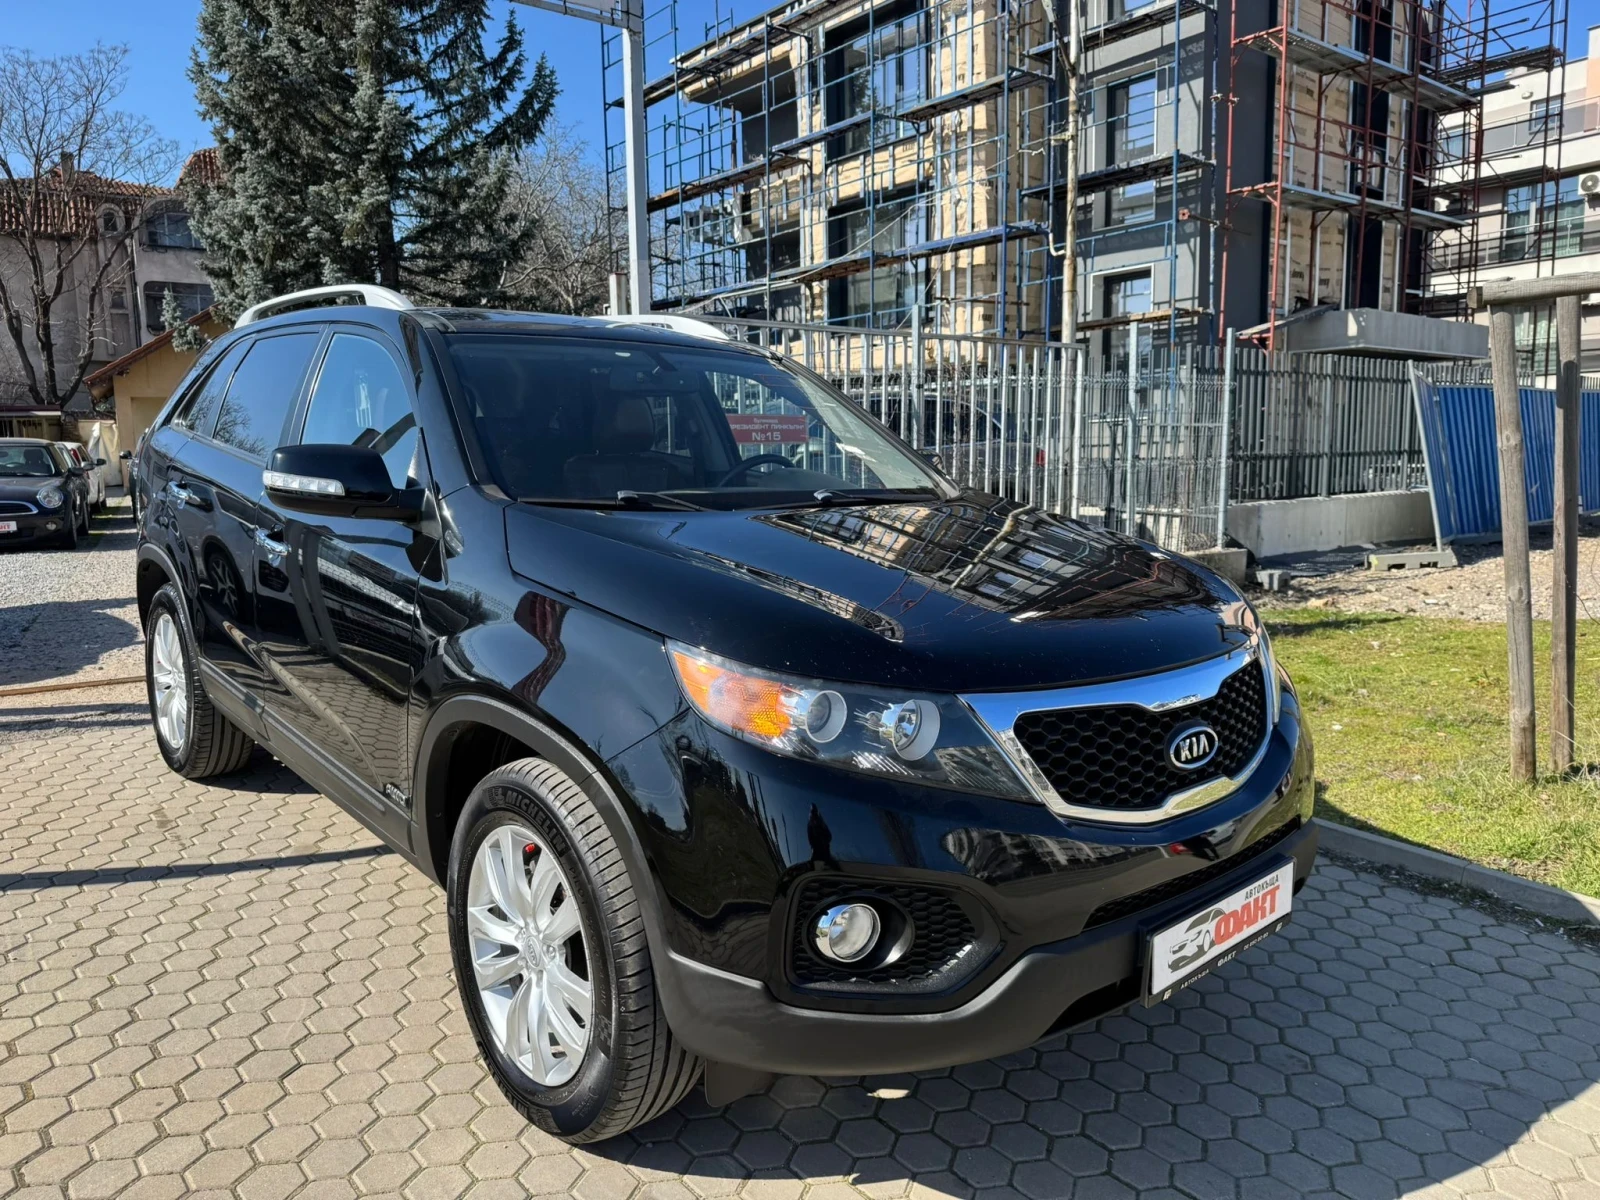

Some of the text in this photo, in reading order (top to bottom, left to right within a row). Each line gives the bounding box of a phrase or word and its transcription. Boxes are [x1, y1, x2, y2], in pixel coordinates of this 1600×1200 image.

[752, 432, 781, 441] №15
[1179, 734, 1210, 762] KIA
[504, 790, 567, 856] MICHELIN
[569, 867, 586, 905] PILOT
[1244, 874, 1279, 900] АВТОКЪЩА
[1214, 884, 1280, 945] ФАКТ
[1217, 951, 1237, 967] ФАКТ
